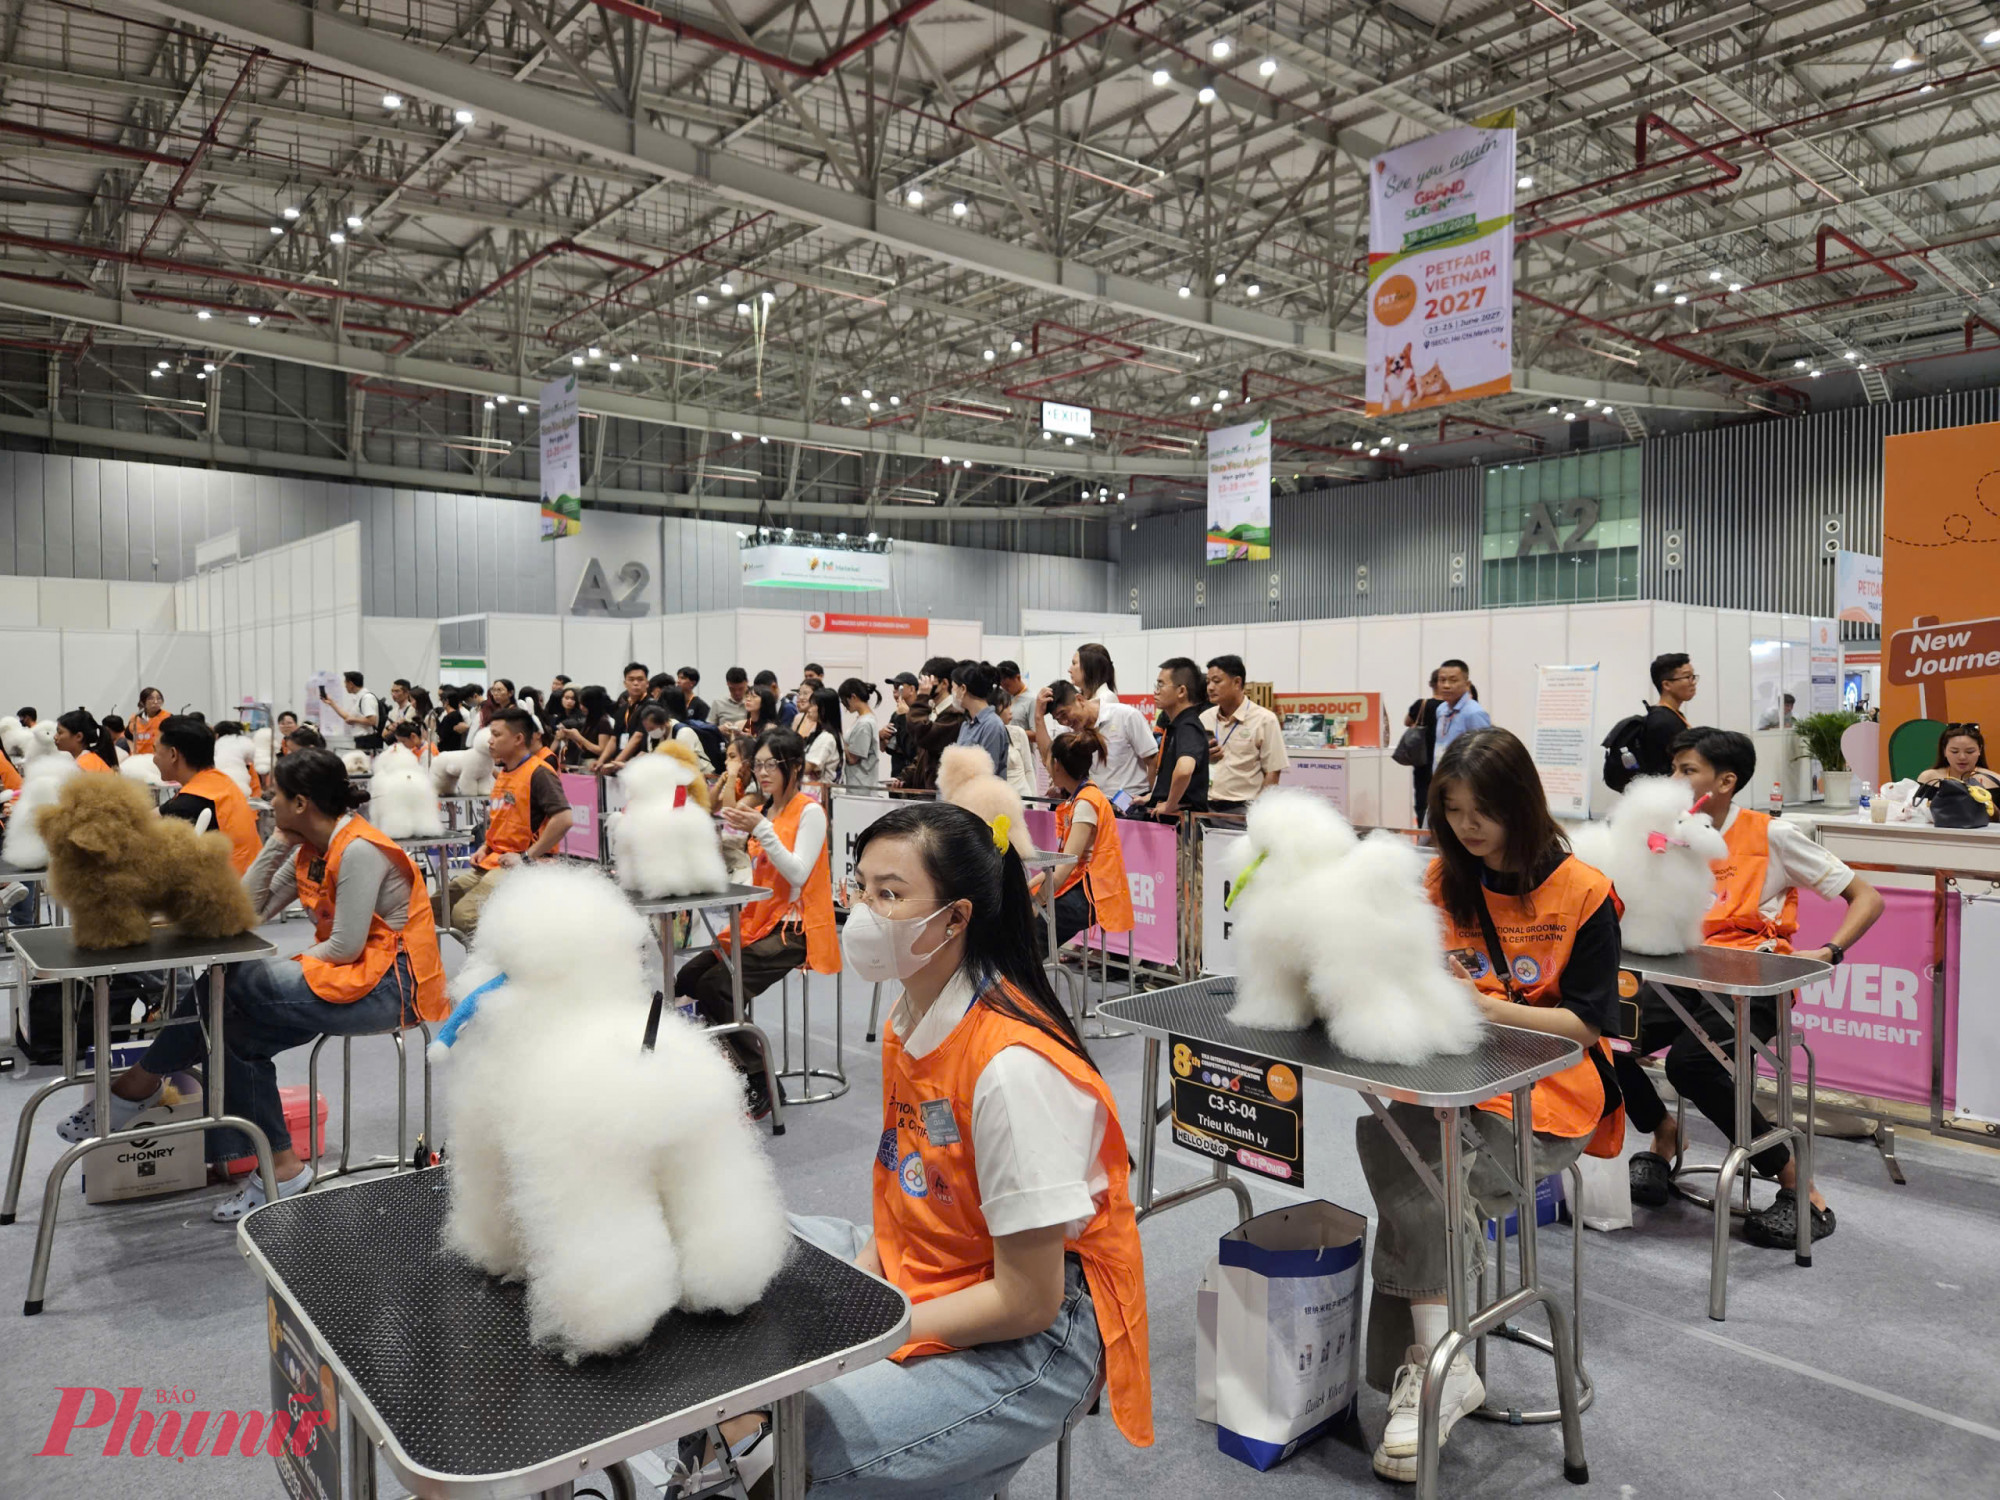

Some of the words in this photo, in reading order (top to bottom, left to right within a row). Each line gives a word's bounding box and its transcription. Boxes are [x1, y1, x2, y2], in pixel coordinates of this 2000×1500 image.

[1384, 174, 1412, 199] See
[1416, 165, 1443, 189] you
[1449, 137, 1498, 167] again
[1426, 250, 1491, 278] PETFAIR
[1425, 264, 1497, 293] VIETNAM
[1425, 286, 1487, 320] 2027
[1460, 317, 1480, 327] June
[1053, 409, 1080, 422] EXIT
[1516, 498, 1599, 557] A2
[569, 557, 651, 619] A2
[1910, 630, 1972, 655] New
[1298, 702, 1362, 714] PRODUCT
[1173, 1043, 1201, 1077] 8th
[1208, 1094, 1257, 1121] C3-S-04
[1177, 1129, 1203, 1147] HELLO
[1198, 1113, 1222, 1131] Trieu
[1224, 1121, 1255, 1142] Khanh
[1257, 1132, 1269, 1148] Ly
[117, 1147, 175, 1163] CHONRY
[1305, 1391, 1325, 1415] Quick
